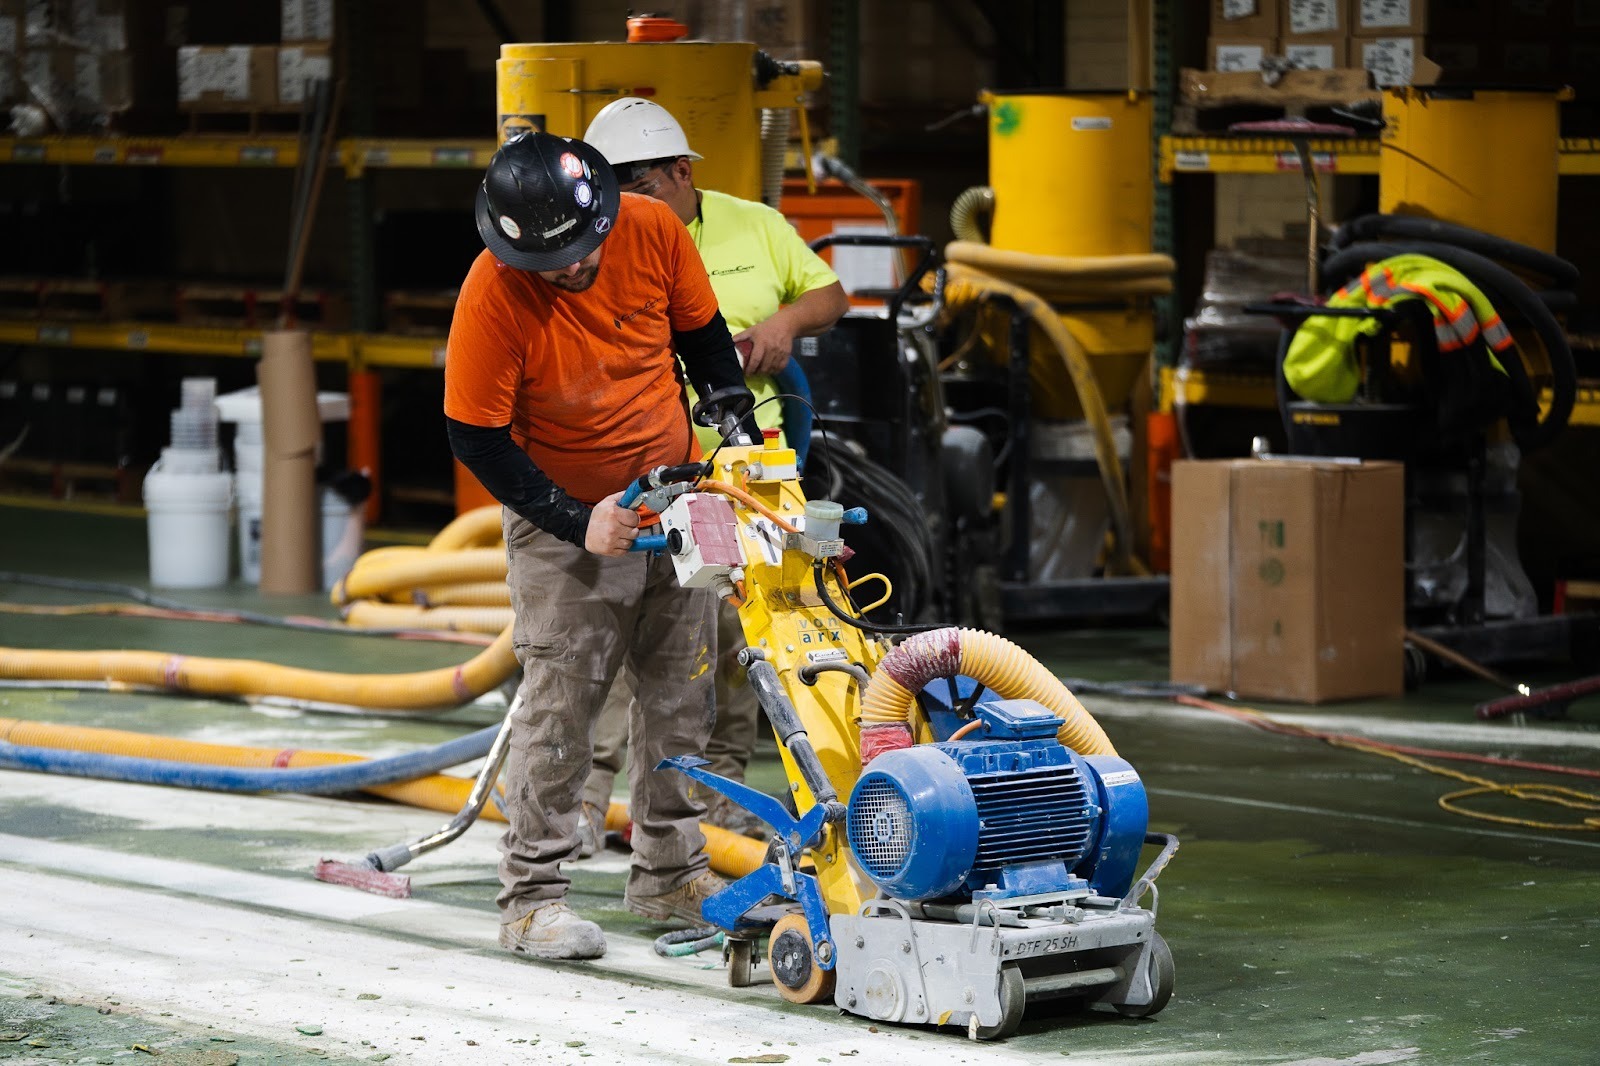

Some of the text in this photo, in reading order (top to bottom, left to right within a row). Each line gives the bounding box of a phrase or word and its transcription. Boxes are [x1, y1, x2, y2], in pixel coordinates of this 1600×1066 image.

[798, 617, 838, 629] von
[802, 631, 840, 643] arx
[1016, 935, 1078, 955] DTF 25 SH
